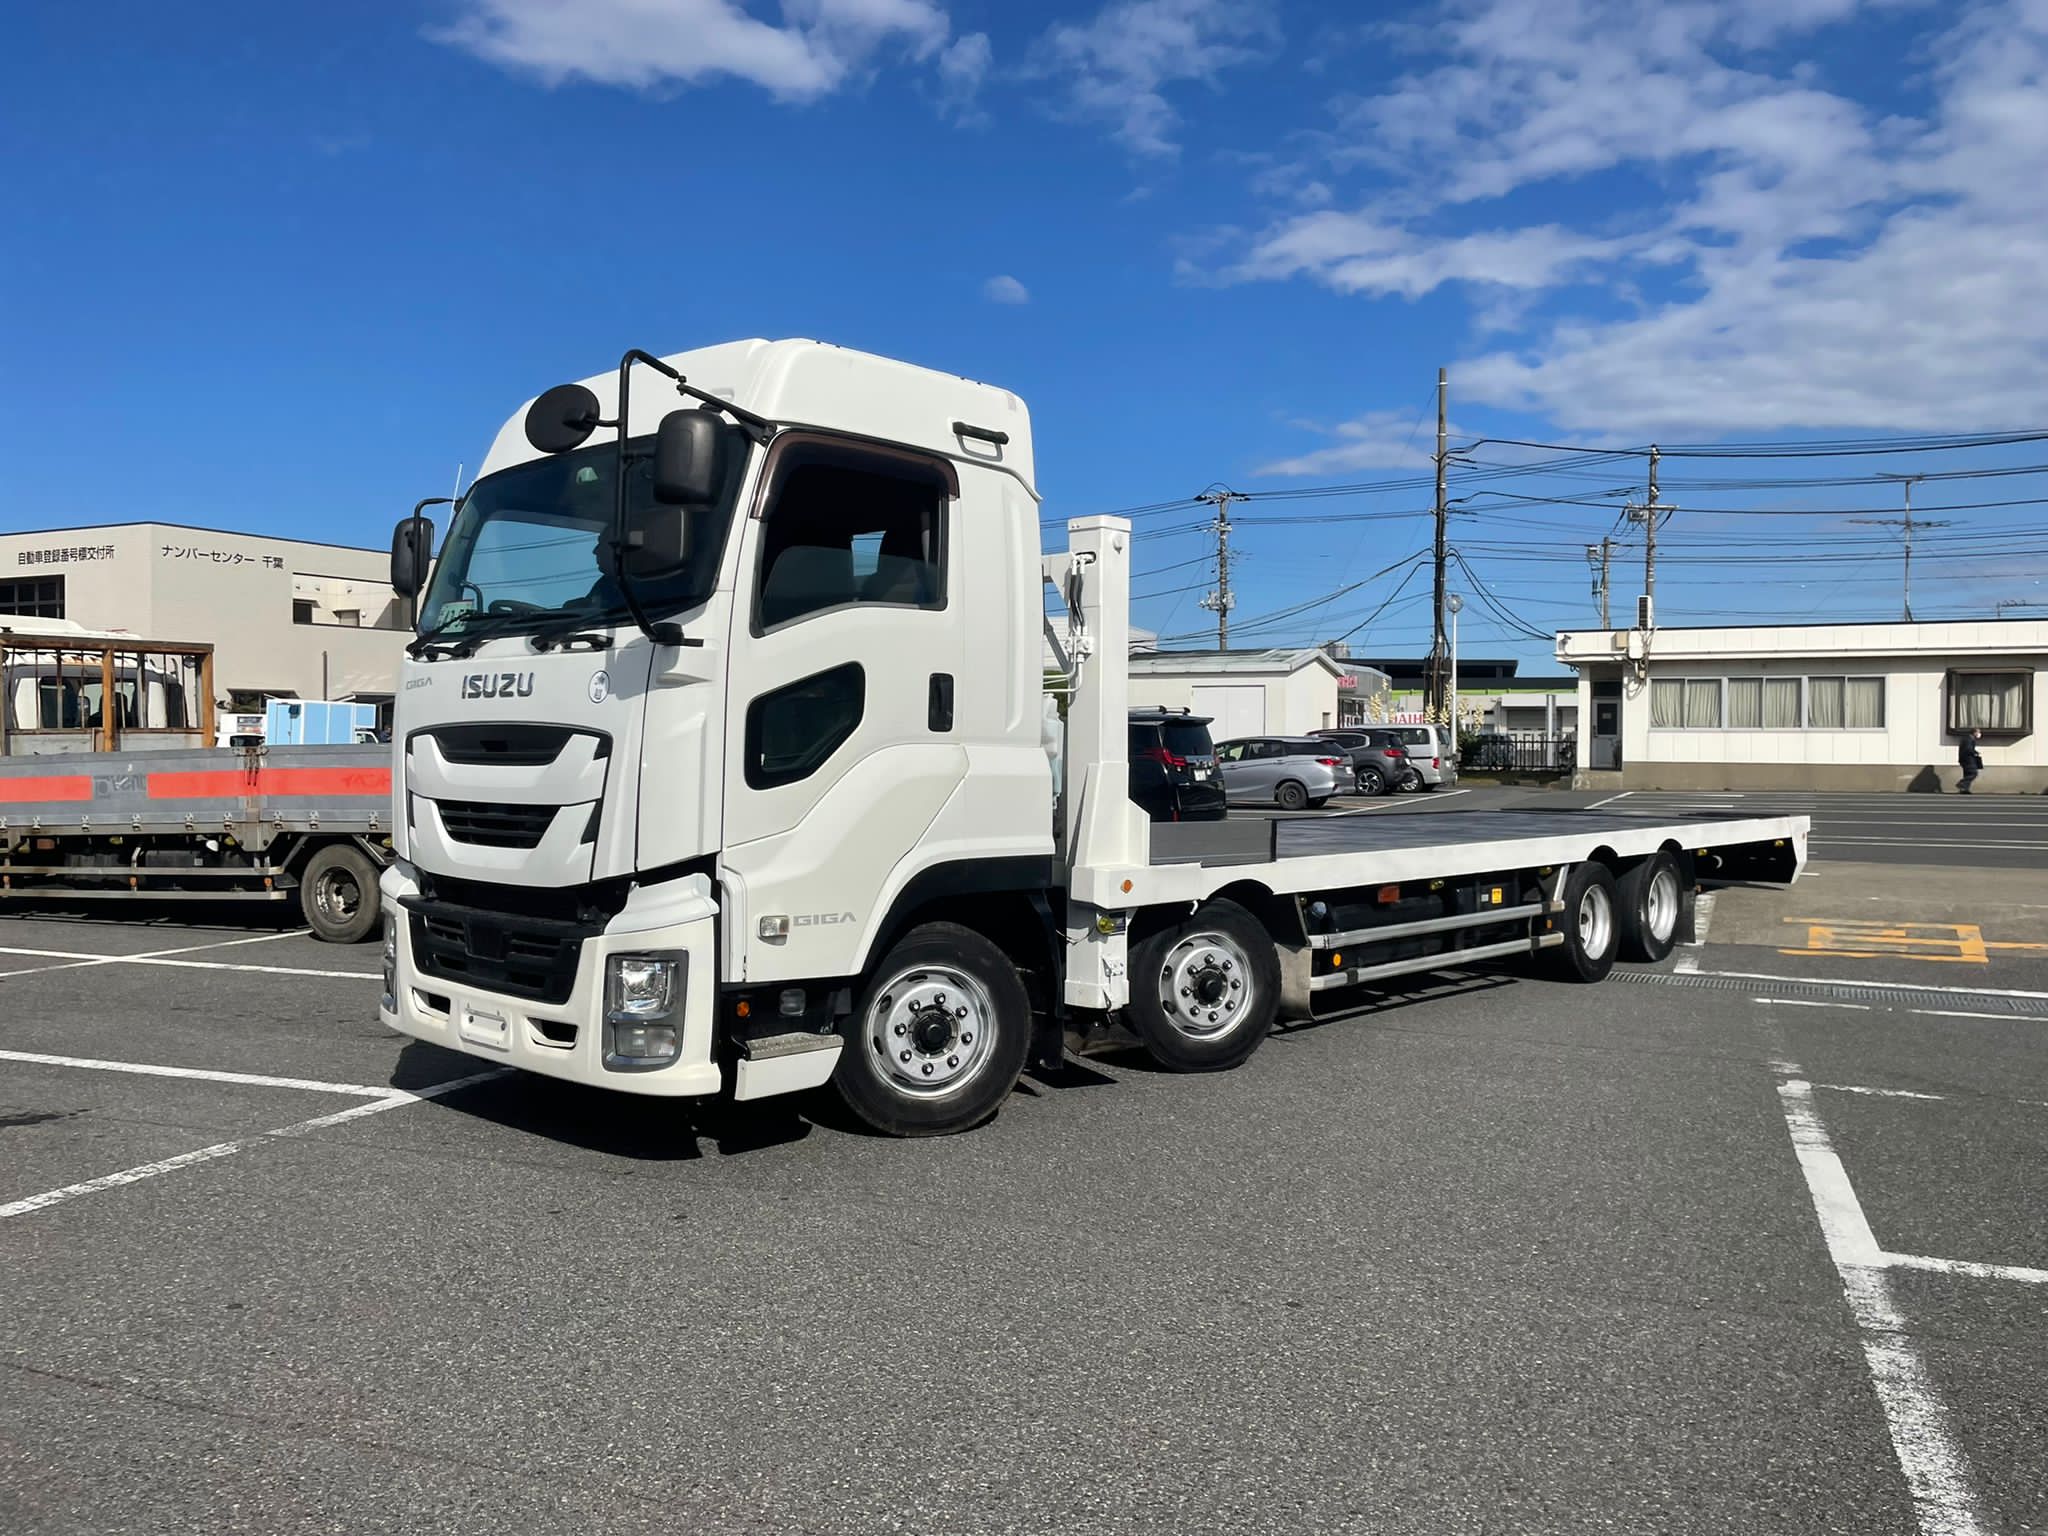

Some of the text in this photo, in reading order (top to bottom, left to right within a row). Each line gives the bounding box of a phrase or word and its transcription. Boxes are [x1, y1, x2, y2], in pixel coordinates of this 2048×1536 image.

[161, 544, 285, 570] ナンバーセンター 千葉
[405, 676, 433, 690] GIGA
[461, 672, 535, 699] ISUZU
[793, 911, 857, 927] GIGA
